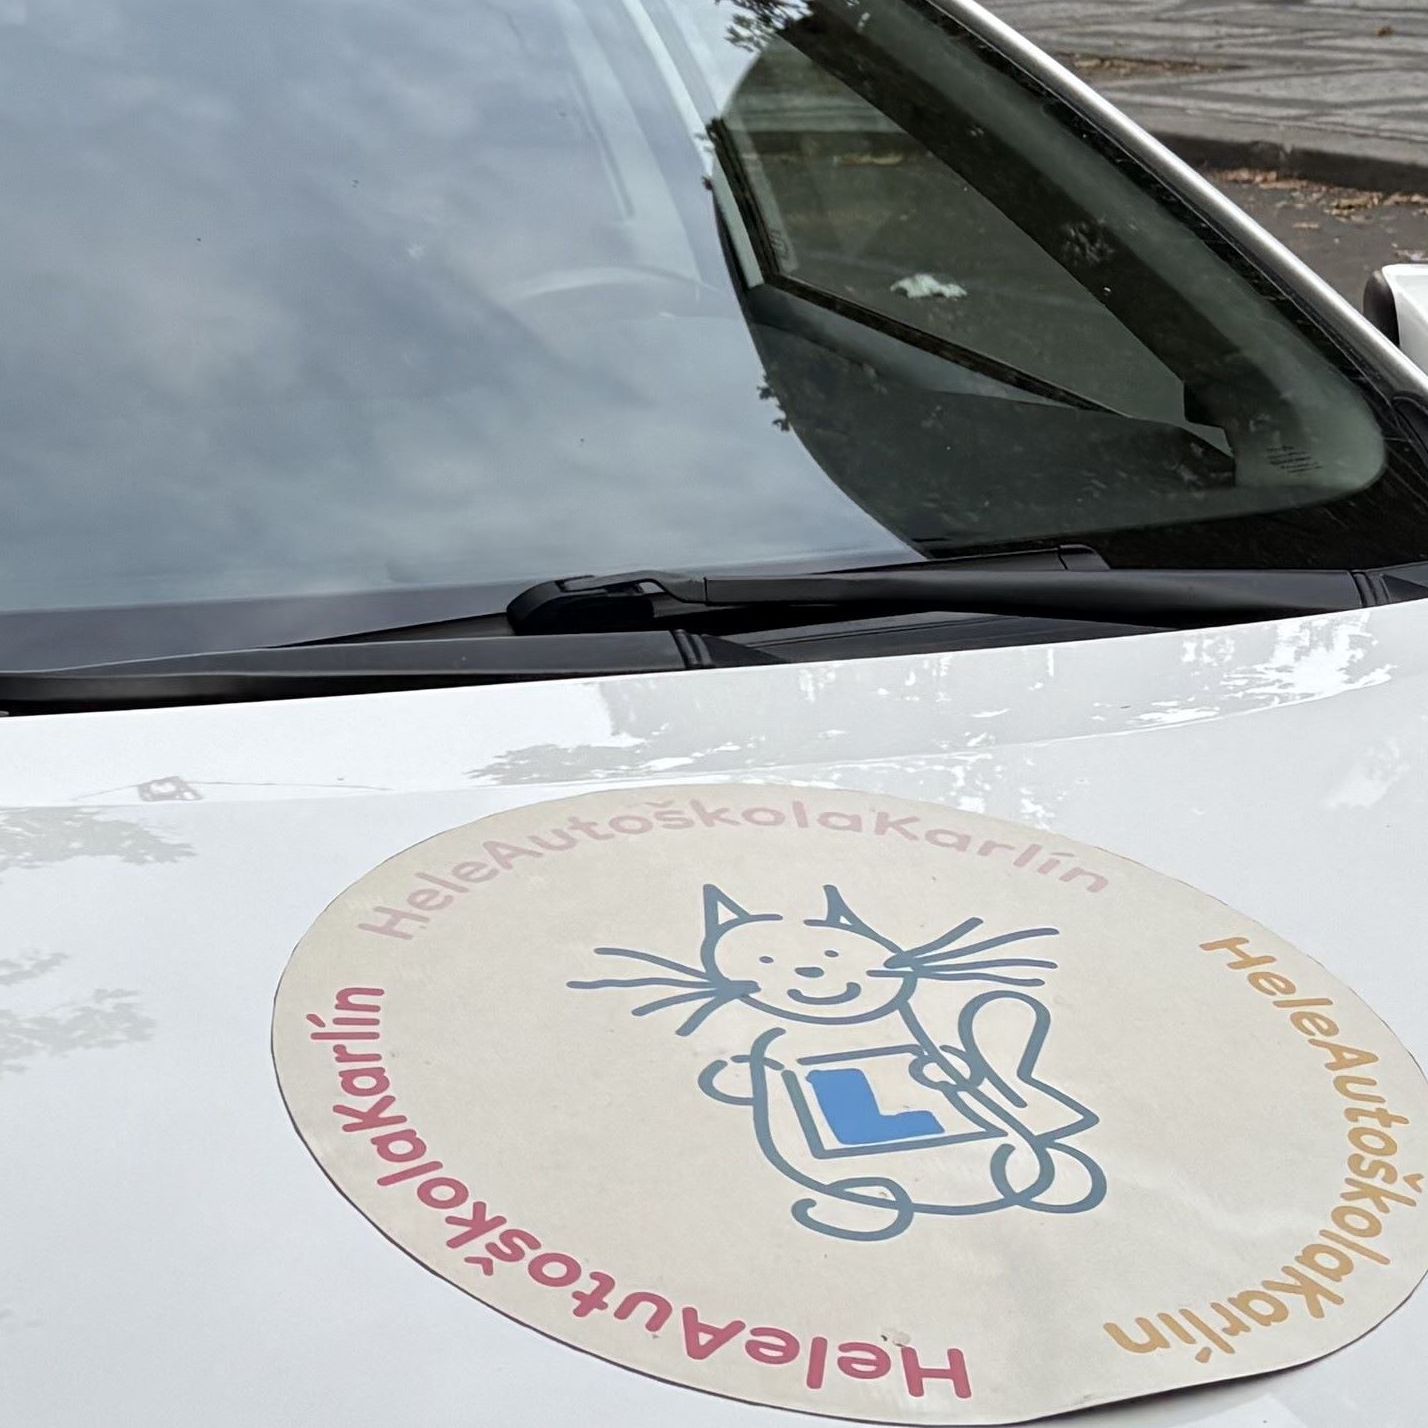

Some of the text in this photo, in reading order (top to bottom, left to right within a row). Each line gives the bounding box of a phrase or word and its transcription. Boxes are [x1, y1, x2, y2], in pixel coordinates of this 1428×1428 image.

[358, 798, 1109, 940] HeleAutoškolaKarlín
[306, 987, 972, 1398] HeleAutoškolaKarlín
[1103, 936, 1424, 1363] HeleAutoškolaKarlín
